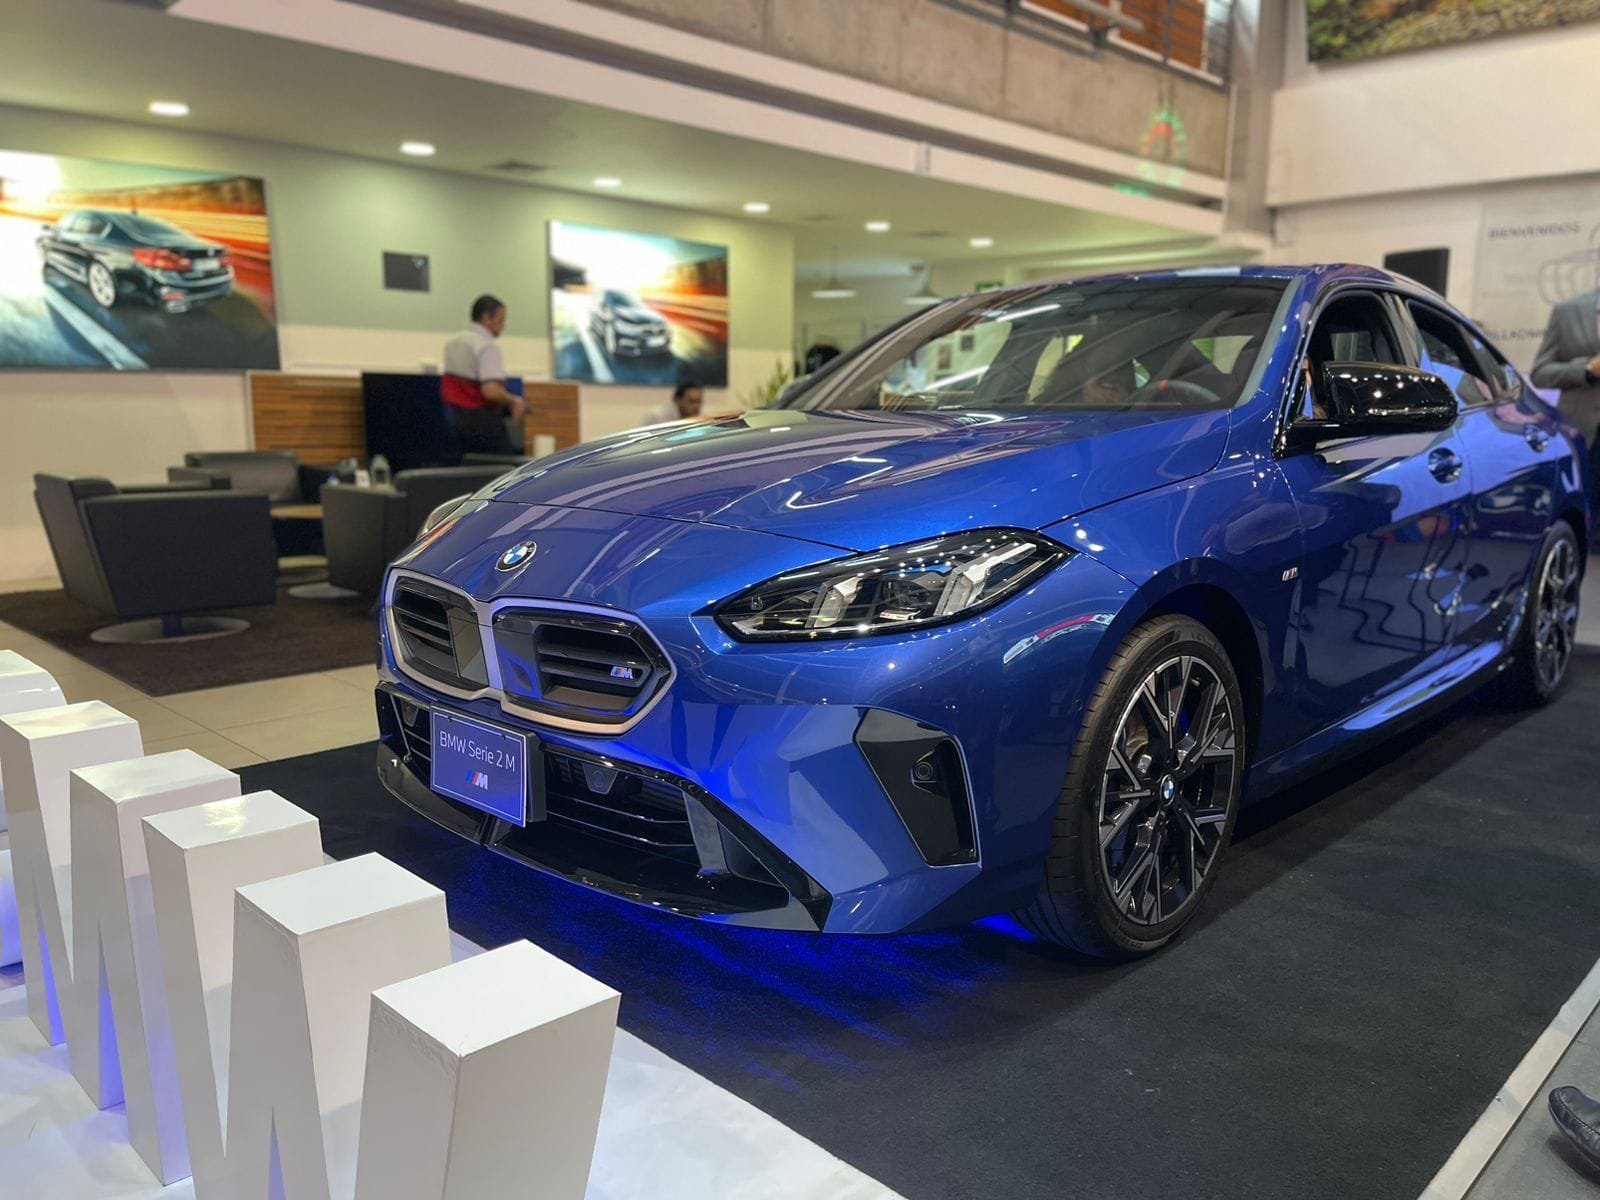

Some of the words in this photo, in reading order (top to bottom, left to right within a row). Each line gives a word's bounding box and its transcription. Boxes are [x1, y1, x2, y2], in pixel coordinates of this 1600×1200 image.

[440, 730, 466, 754] BMW
[468, 740, 494, 765] Serie
[496, 749, 503, 768] 2
[505, 753, 515, 772] M
